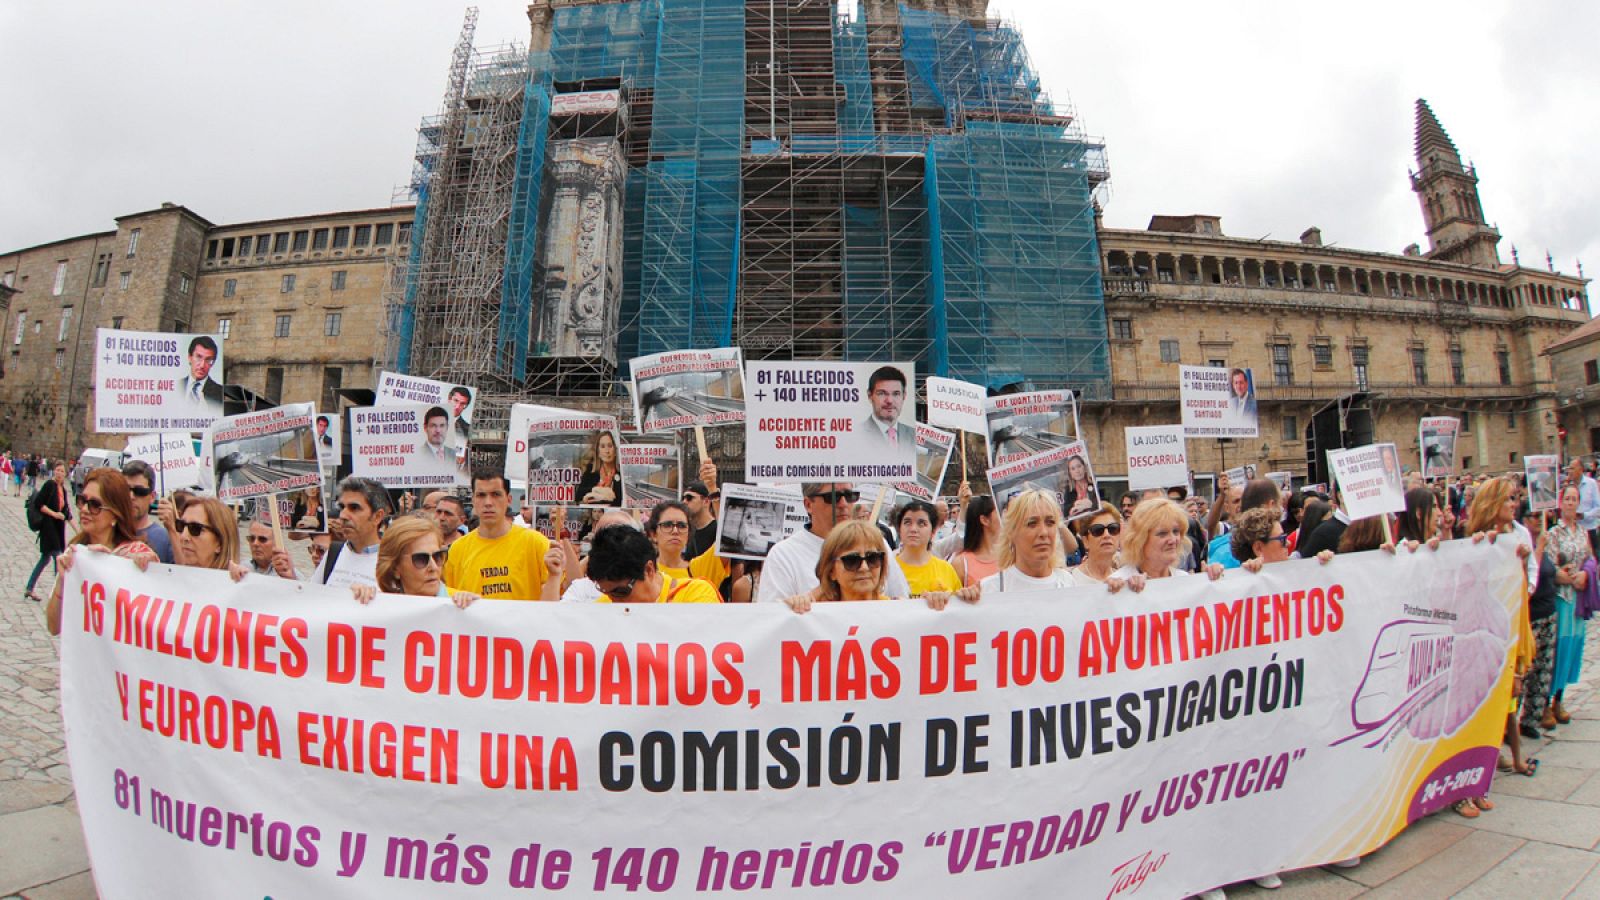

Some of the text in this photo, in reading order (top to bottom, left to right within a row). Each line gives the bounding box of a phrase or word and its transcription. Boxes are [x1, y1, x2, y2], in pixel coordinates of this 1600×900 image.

[106, 337, 177, 353] 81 FALLECIDOS
[116, 353, 134, 366] 140
[137, 355, 181, 367] HERIDOS
[757, 370, 854, 385] 81 FALLECIDOS
[1192, 371, 1227, 381] FALLECIDOS
[105, 378, 155, 391] ACCIDENTE
[385, 377, 440, 394] 81 FALLECIDOS
[1204, 383, 1230, 391] HERIDOS
[117, 393, 162, 405] SANTIAGO
[408, 392, 441, 404] HERIDOS
[773, 388, 797, 402] 140
[802, 388, 860, 402] HERIDOS
[948, 387, 979, 399] JUSTICIA
[995, 399, 1007, 408] WE
[1011, 396, 1030, 405] WANT
[1186, 400, 1216, 408] ACCIDENTE
[357, 412, 415, 423] 81 FALLECIDOS
[1194, 410, 1222, 418] SANTIAGO
[99, 418, 123, 428] NIEGAN
[161, 418, 169, 428] DE
[171, 417, 218, 428] INVESTIGACI
[235, 414, 271, 427] QUEREMOS
[559, 420, 614, 430] OCULTACIONES
[759, 418, 828, 432] ACCIDENTE
[366, 425, 380, 435] 140
[383, 423, 419, 434] HERIDOS
[775, 436, 836, 449] SANTIAGO
[1133, 434, 1178, 445] LA JUSTICIA
[137, 445, 149, 455] LA
[359, 445, 398, 455] ACCIDENTE
[644, 448, 667, 456] SABER
[369, 457, 405, 467] SANTIAGO
[992, 464, 1026, 479] MENTIRAS
[1034, 445, 1082, 467] OCULTACIONES
[1130, 453, 1184, 468] DESCARRILA
[544, 469, 580, 483] PASTOR
[751, 463, 912, 477] NIEGAN COMISIÓN DE INVESTIGACIÓN
[403, 476, 411, 484] DE
[480, 566, 509, 578] VERDAD
[481, 583, 512, 596] JUSTICIA
[81, 580, 1344, 710] 16 MILLONES DE CIUDADANOS, MÁS DE 100 AYUNTAMIENTOS
[115, 671, 129, 722] Y
[139, 679, 281, 760] EUROPA
[298, 711, 459, 785] EXIGEN
[480, 731, 578, 791] UNA
[599, 712, 901, 793] COMISIÓN
[925, 714, 990, 778] DE
[1010, 652, 1305, 769] INVESTIGACIÓN
[1420, 766, 1484, 804] 24-7-2013
[114, 768, 141, 816] 81
[150, 787, 321, 868] muertos
[336, 831, 367, 878] y
[384, 833, 491, 885] más
[508, 843, 572, 890] de
[592, 847, 679, 893] 140
[696, 840, 903, 892] heridos
[1116, 790, 1142, 833] Y
[1106, 850, 1170, 900] Talgo
